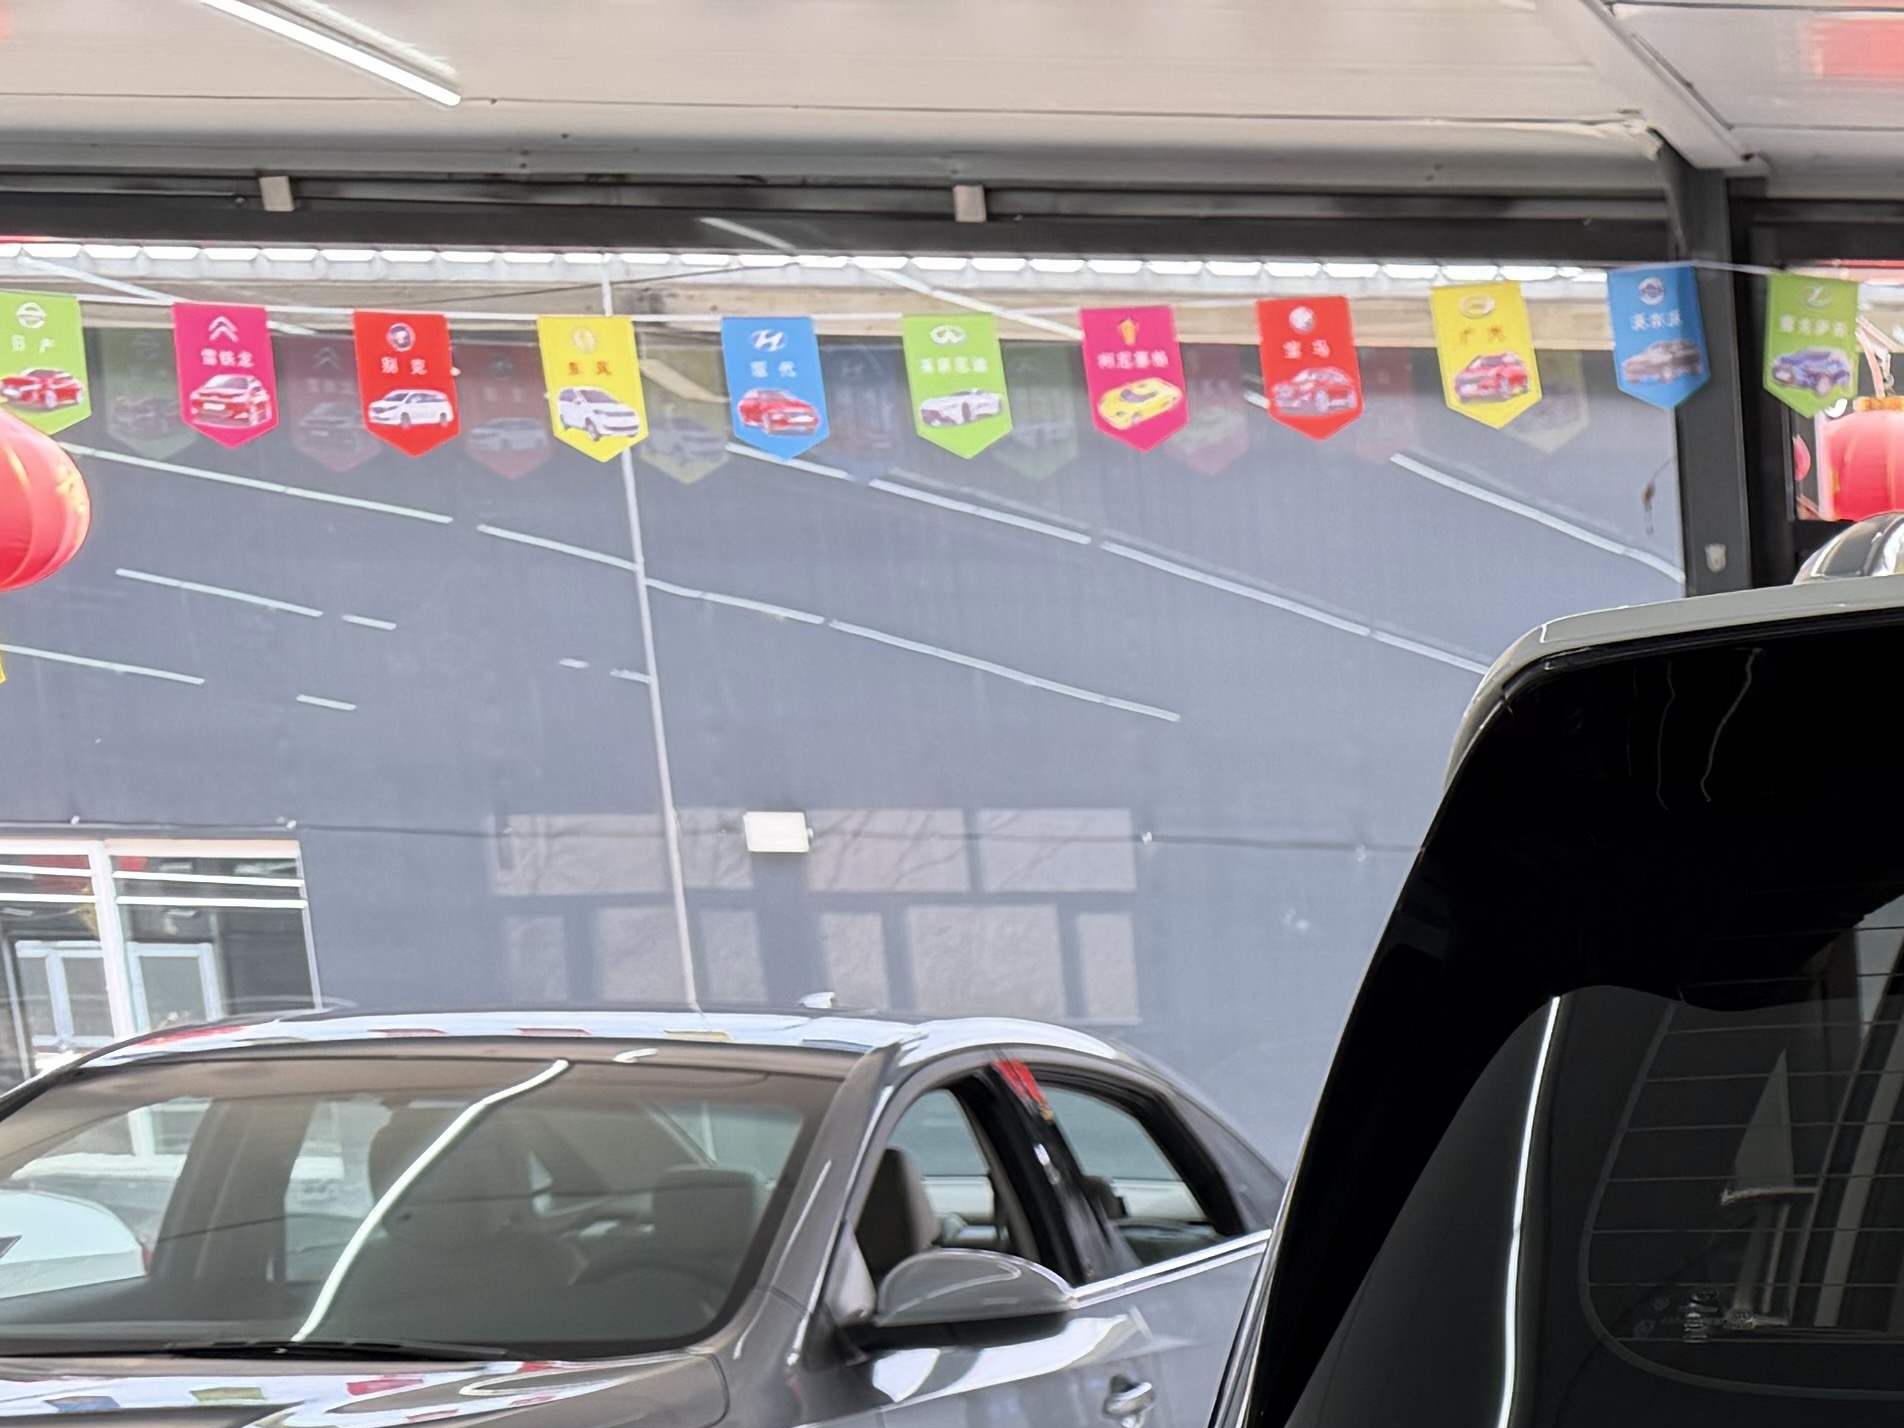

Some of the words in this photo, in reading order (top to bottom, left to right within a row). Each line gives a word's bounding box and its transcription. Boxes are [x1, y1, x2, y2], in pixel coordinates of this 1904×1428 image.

[201, 348, 255, 368] 雪铁龙
[1282, 338, 1332, 360] 宝马
[380, 356, 428, 376] 别克
